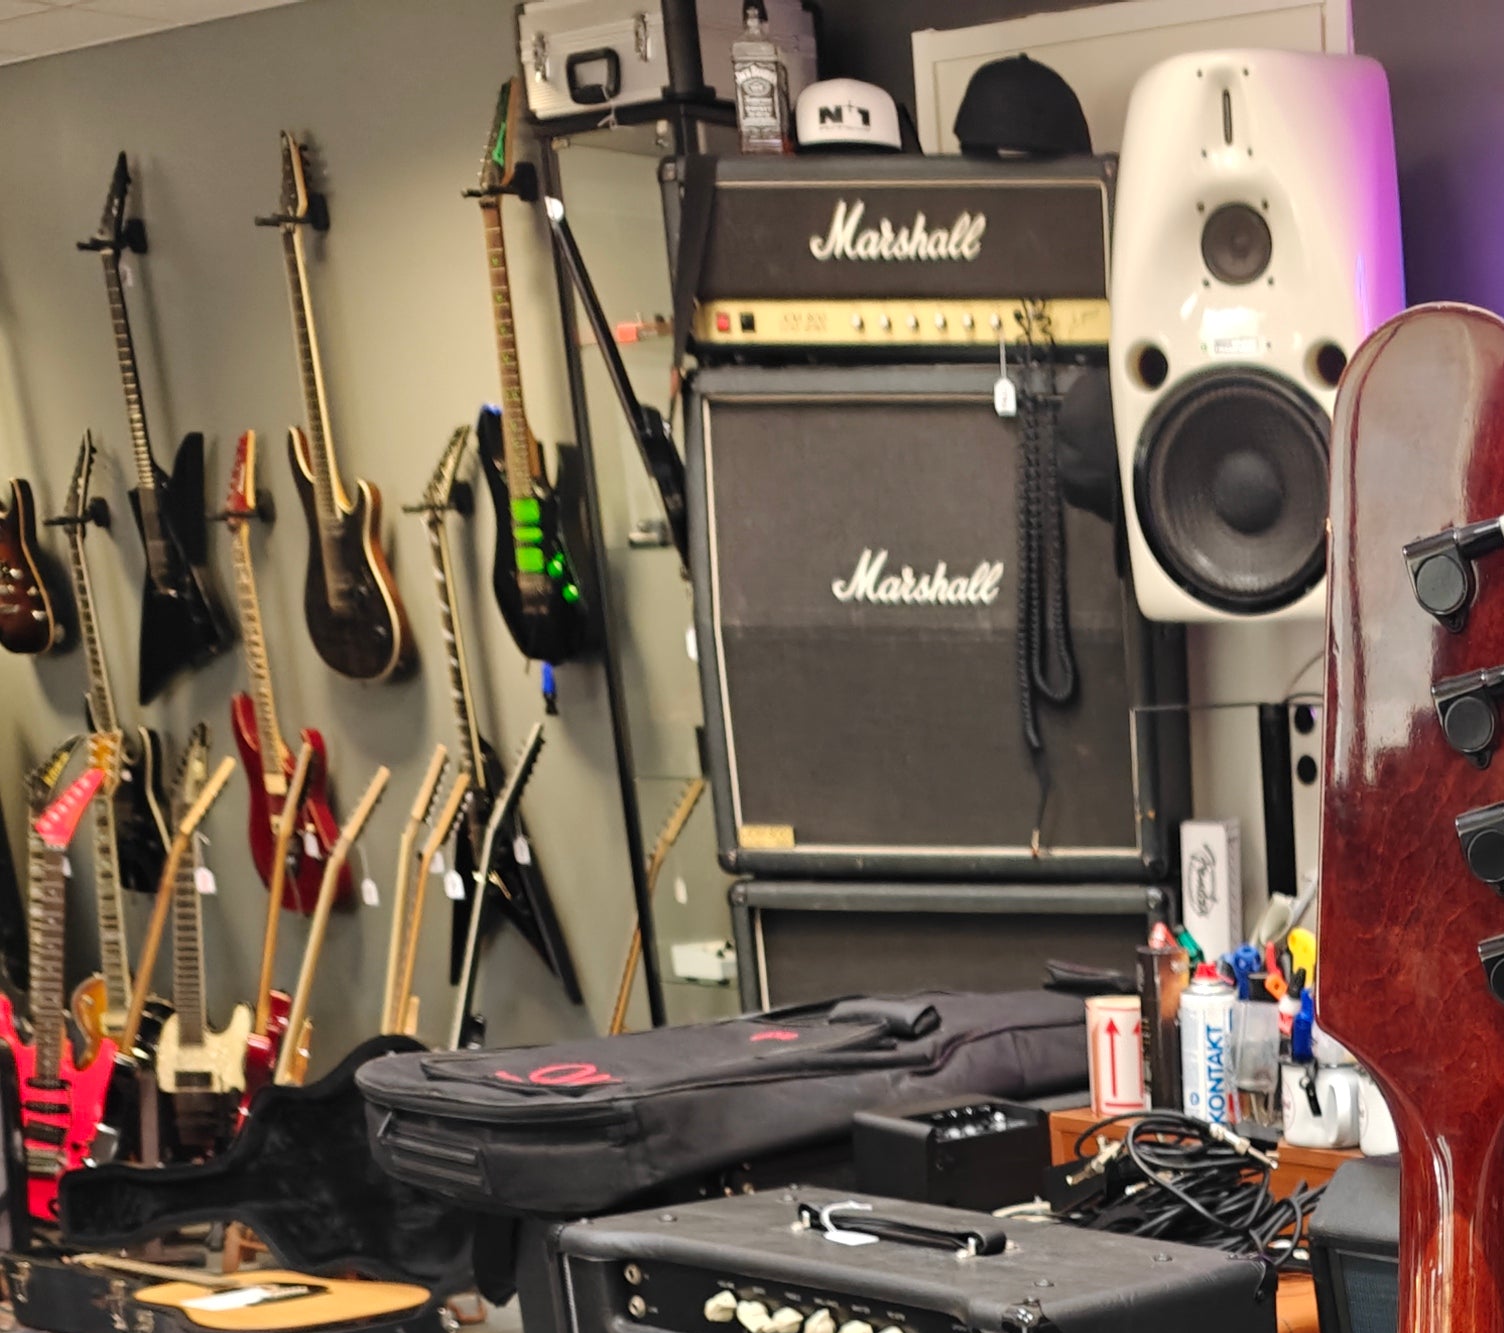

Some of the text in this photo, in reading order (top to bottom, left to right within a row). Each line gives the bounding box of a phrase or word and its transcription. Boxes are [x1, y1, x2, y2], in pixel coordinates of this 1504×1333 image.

[810, 198, 986, 261] Marshall
[831, 546, 1004, 605] Marshall
[1206, 1024, 1226, 1124] KONTAKT
